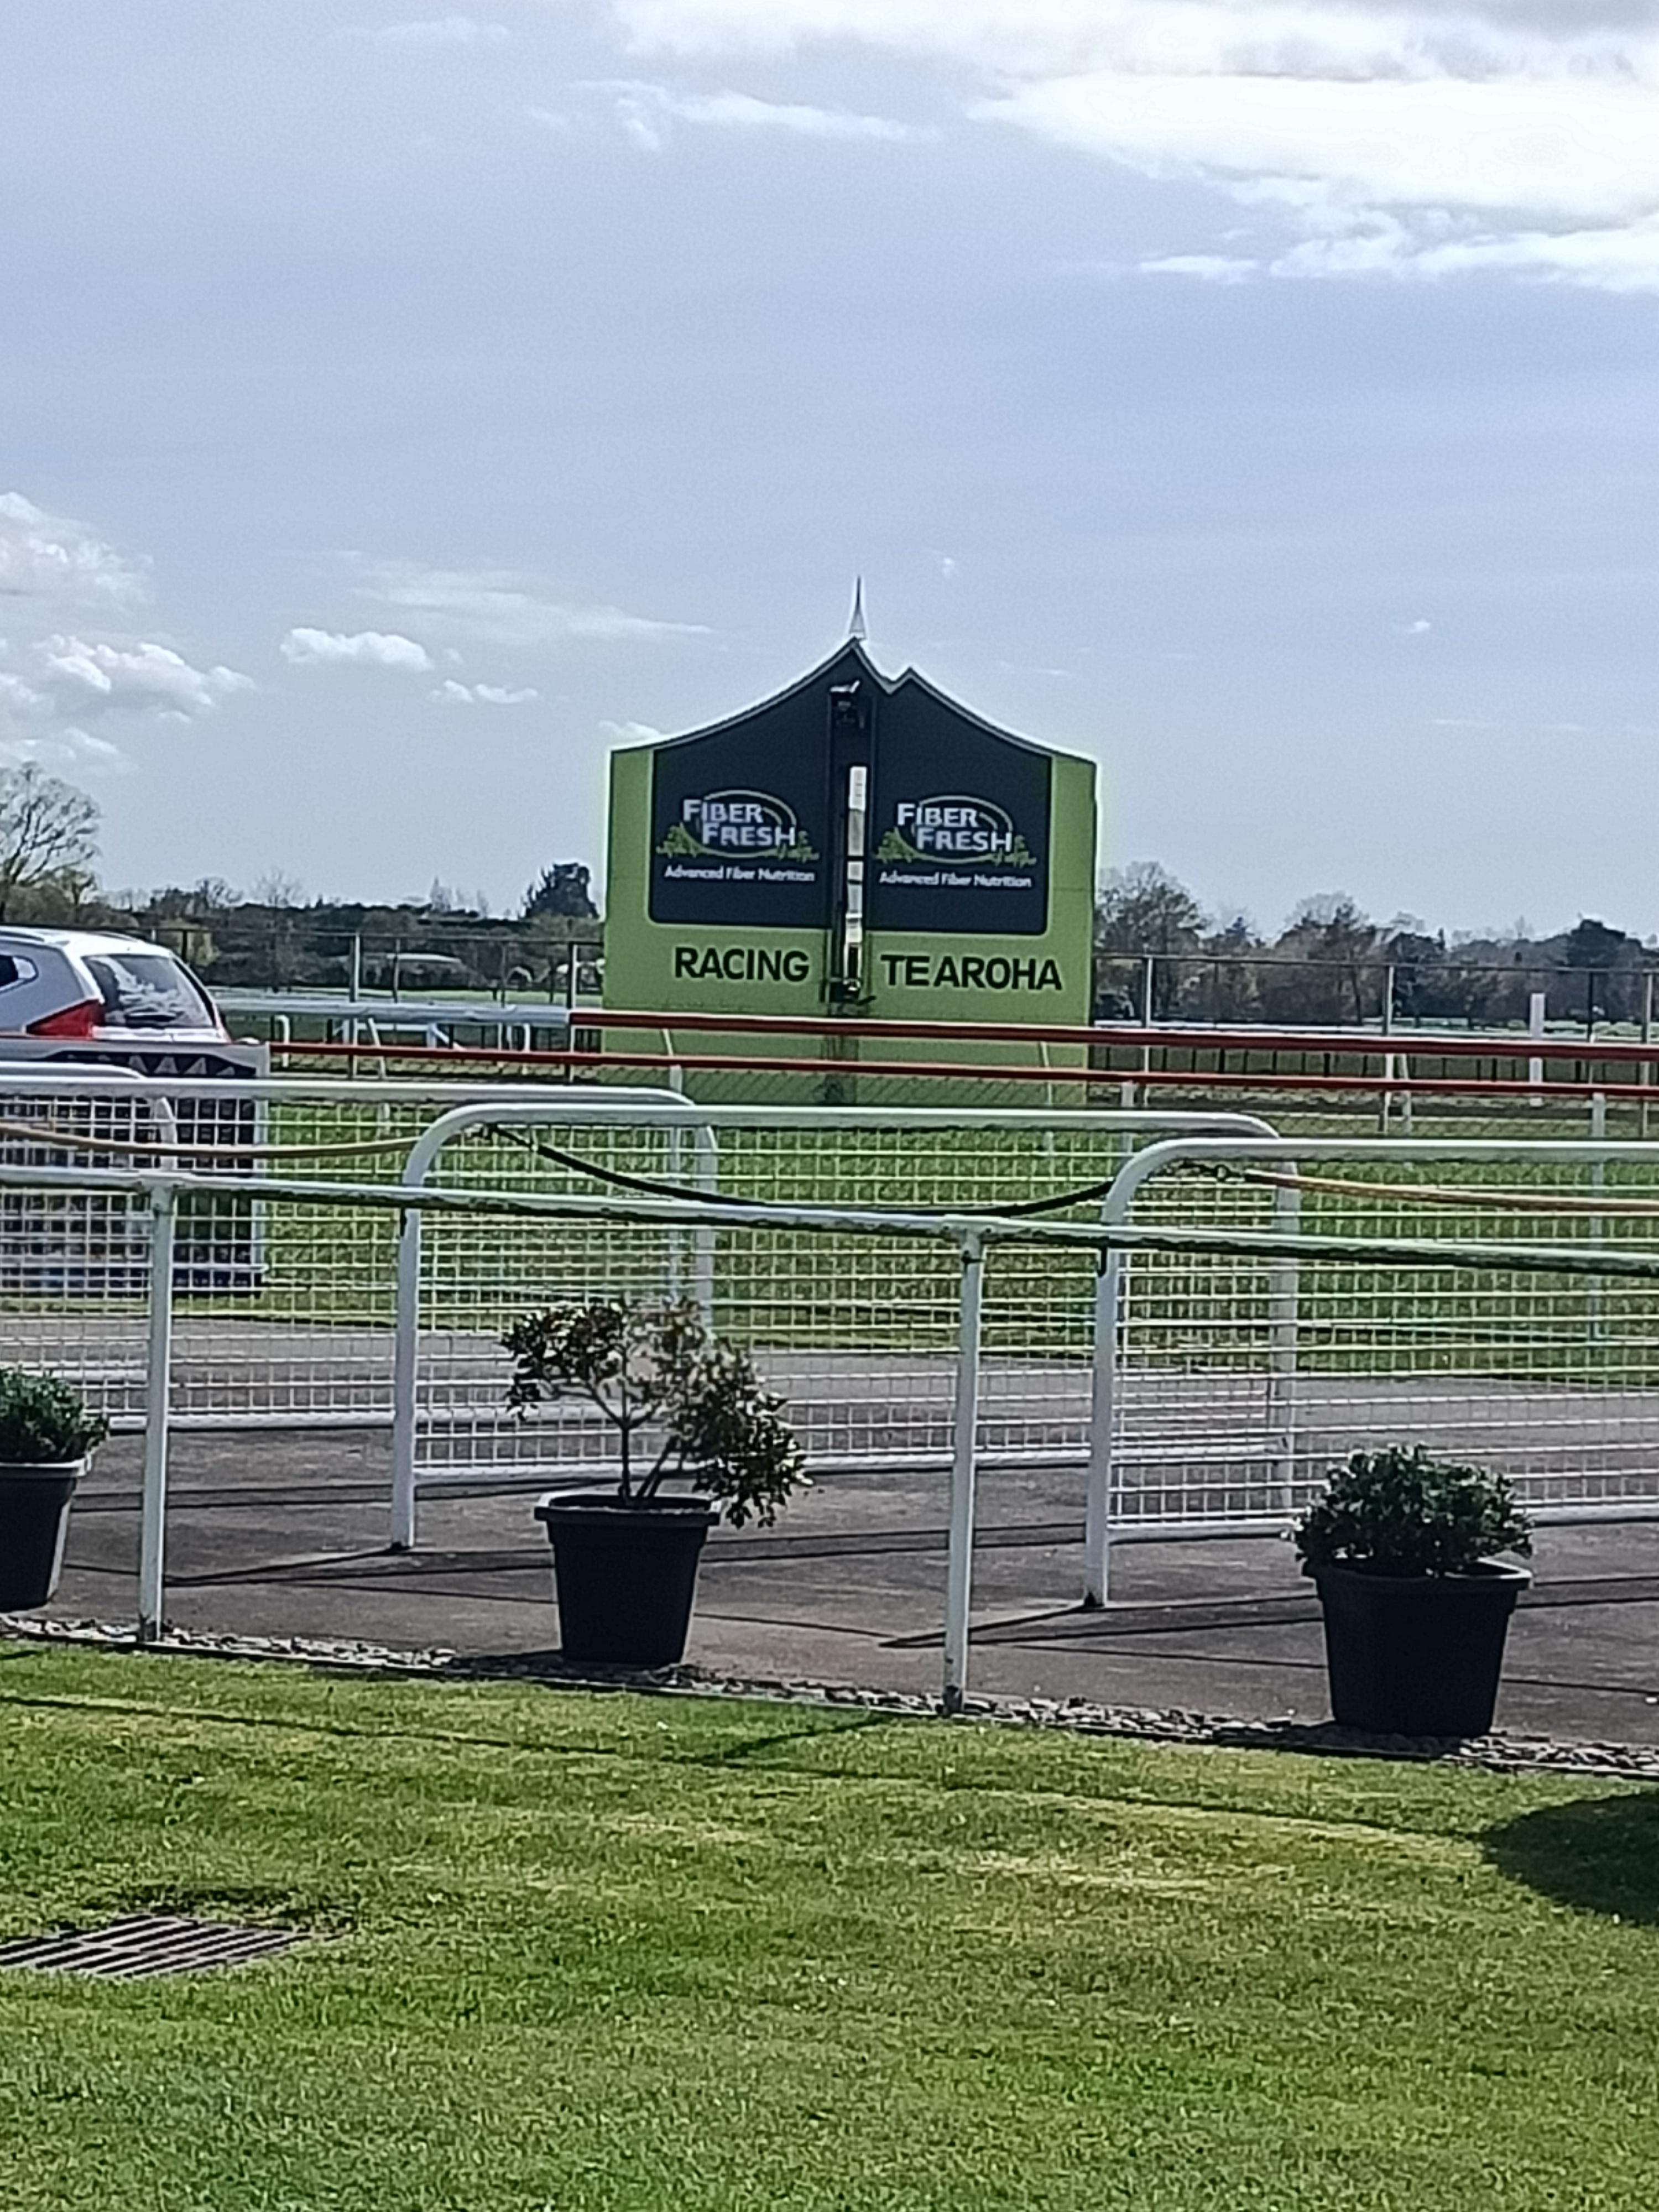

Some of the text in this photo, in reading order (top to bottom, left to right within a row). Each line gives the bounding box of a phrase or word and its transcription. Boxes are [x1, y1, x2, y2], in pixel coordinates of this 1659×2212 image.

[683, 799, 764, 823] FIBER
[897, 803, 979, 828] FIBER
[702, 822, 795, 846] FRESH
[916, 827, 1013, 852] FRESH
[664, 864, 815, 881] Advanced Fiber Nutrition
[879, 869, 1032, 888] Advanced Fiber Nutrition
[675, 947, 810, 982] RACING
